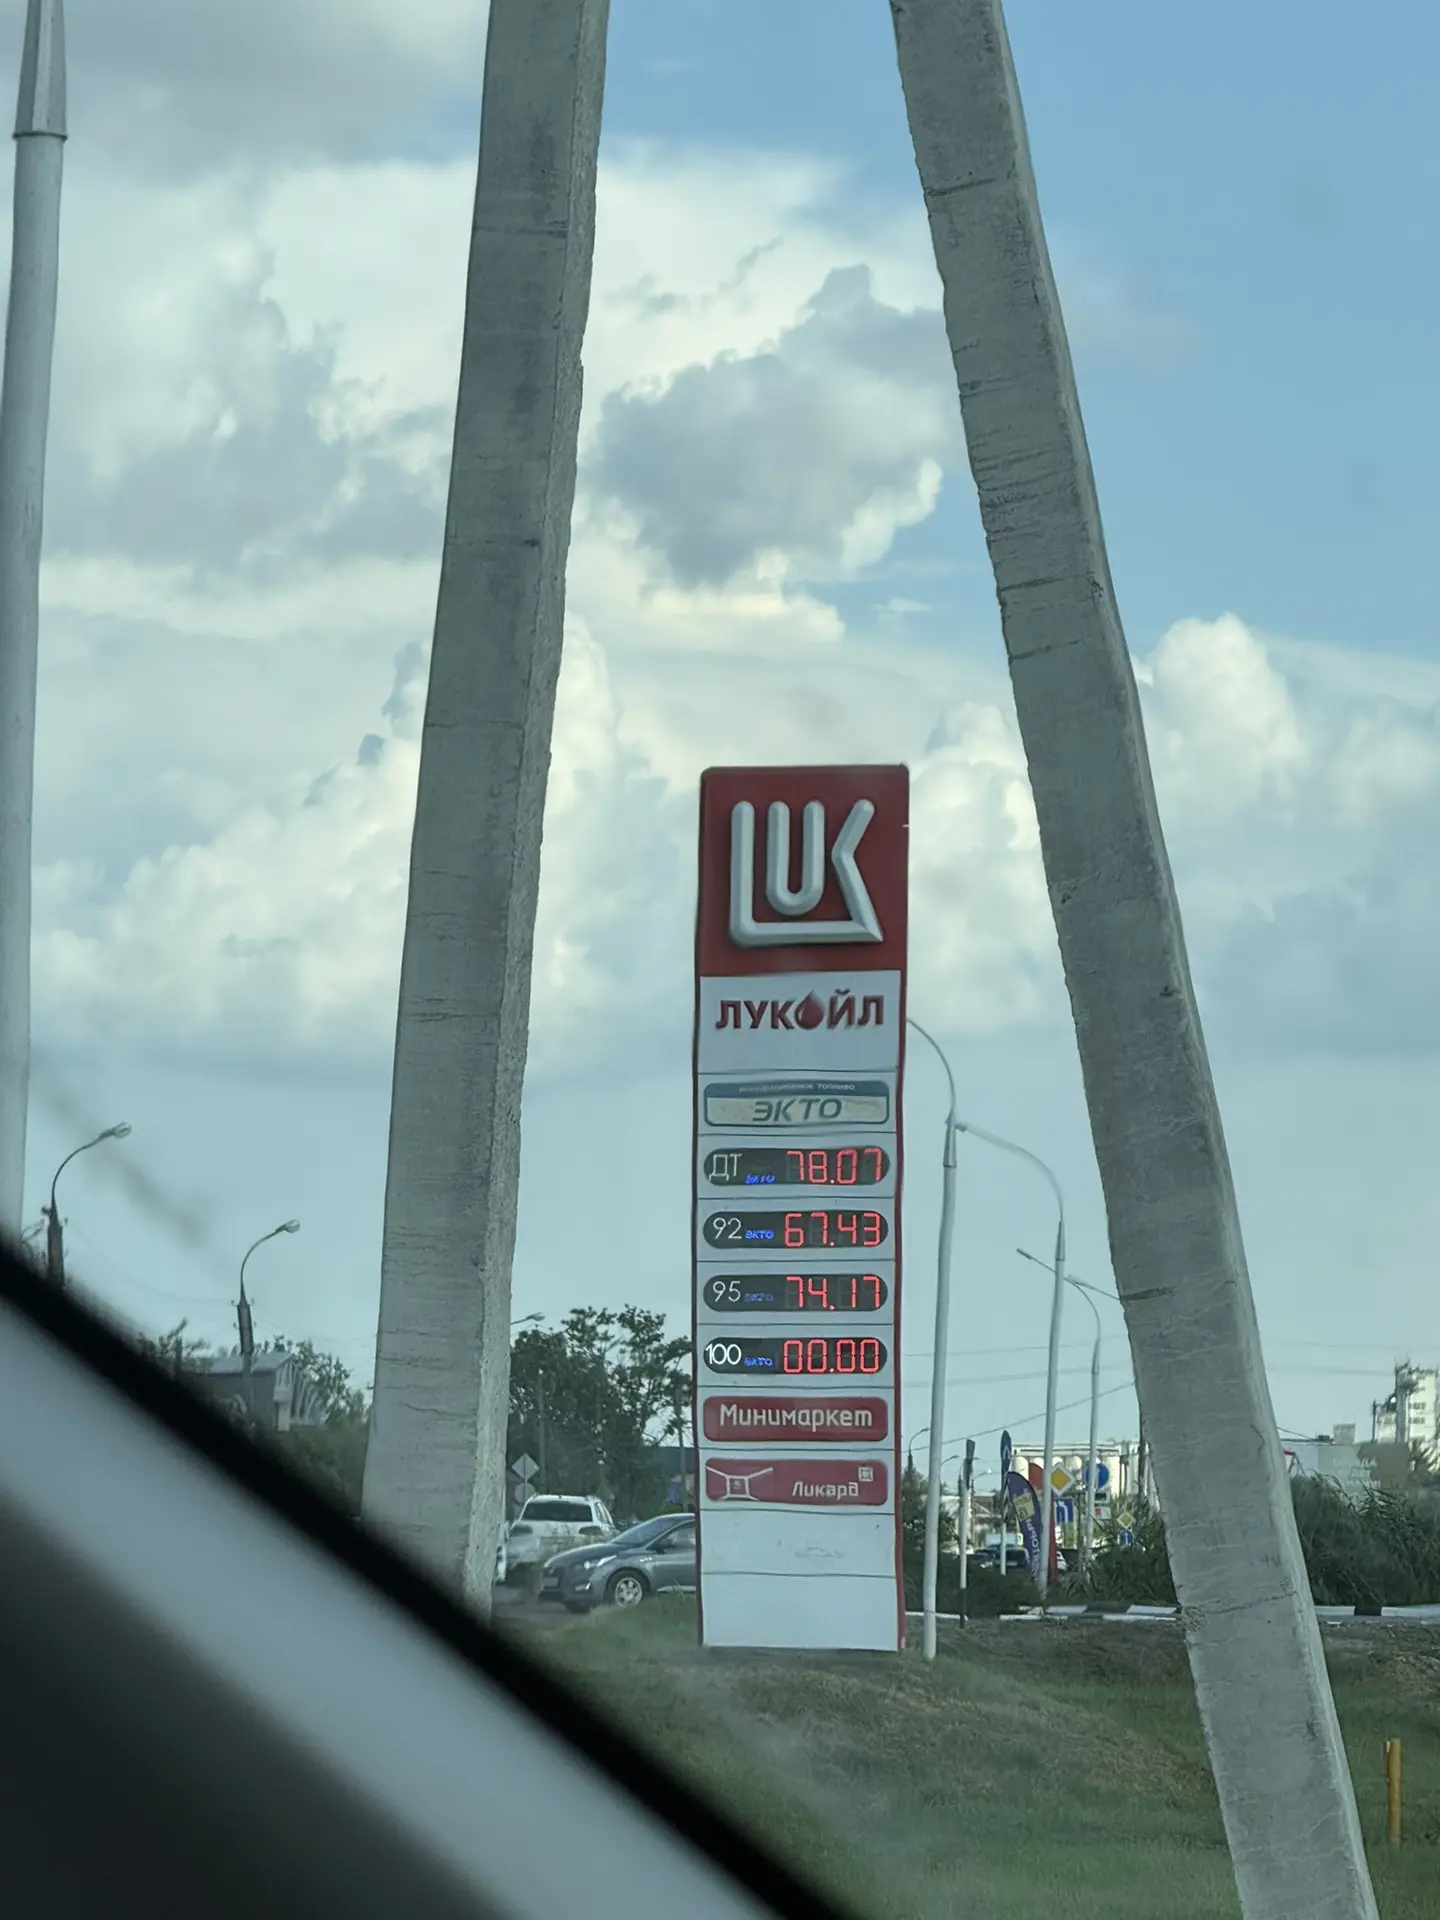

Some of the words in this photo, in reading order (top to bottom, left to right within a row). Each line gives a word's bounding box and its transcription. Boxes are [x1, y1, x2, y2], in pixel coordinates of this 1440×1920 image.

[715, 988, 884, 1031] ЛУКОЙЛ
[752, 1098, 843, 1123] ЭКТО
[708, 1153, 742, 1182] ДТ
[787, 1147, 882, 1184] 78.07
[712, 1217, 743, 1240] 92
[745, 1230, 775, 1240] ЭКТО
[784, 1211, 881, 1247] 67.43
[712, 1280, 741, 1303] 95
[786, 1275, 881, 1310] 74.17
[705, 1343, 742, 1366] 100
[783, 1339, 880, 1374] 00.00
[719, 1404, 873, 1433] Минимаркет
[791, 1480, 860, 1500] Ликард
